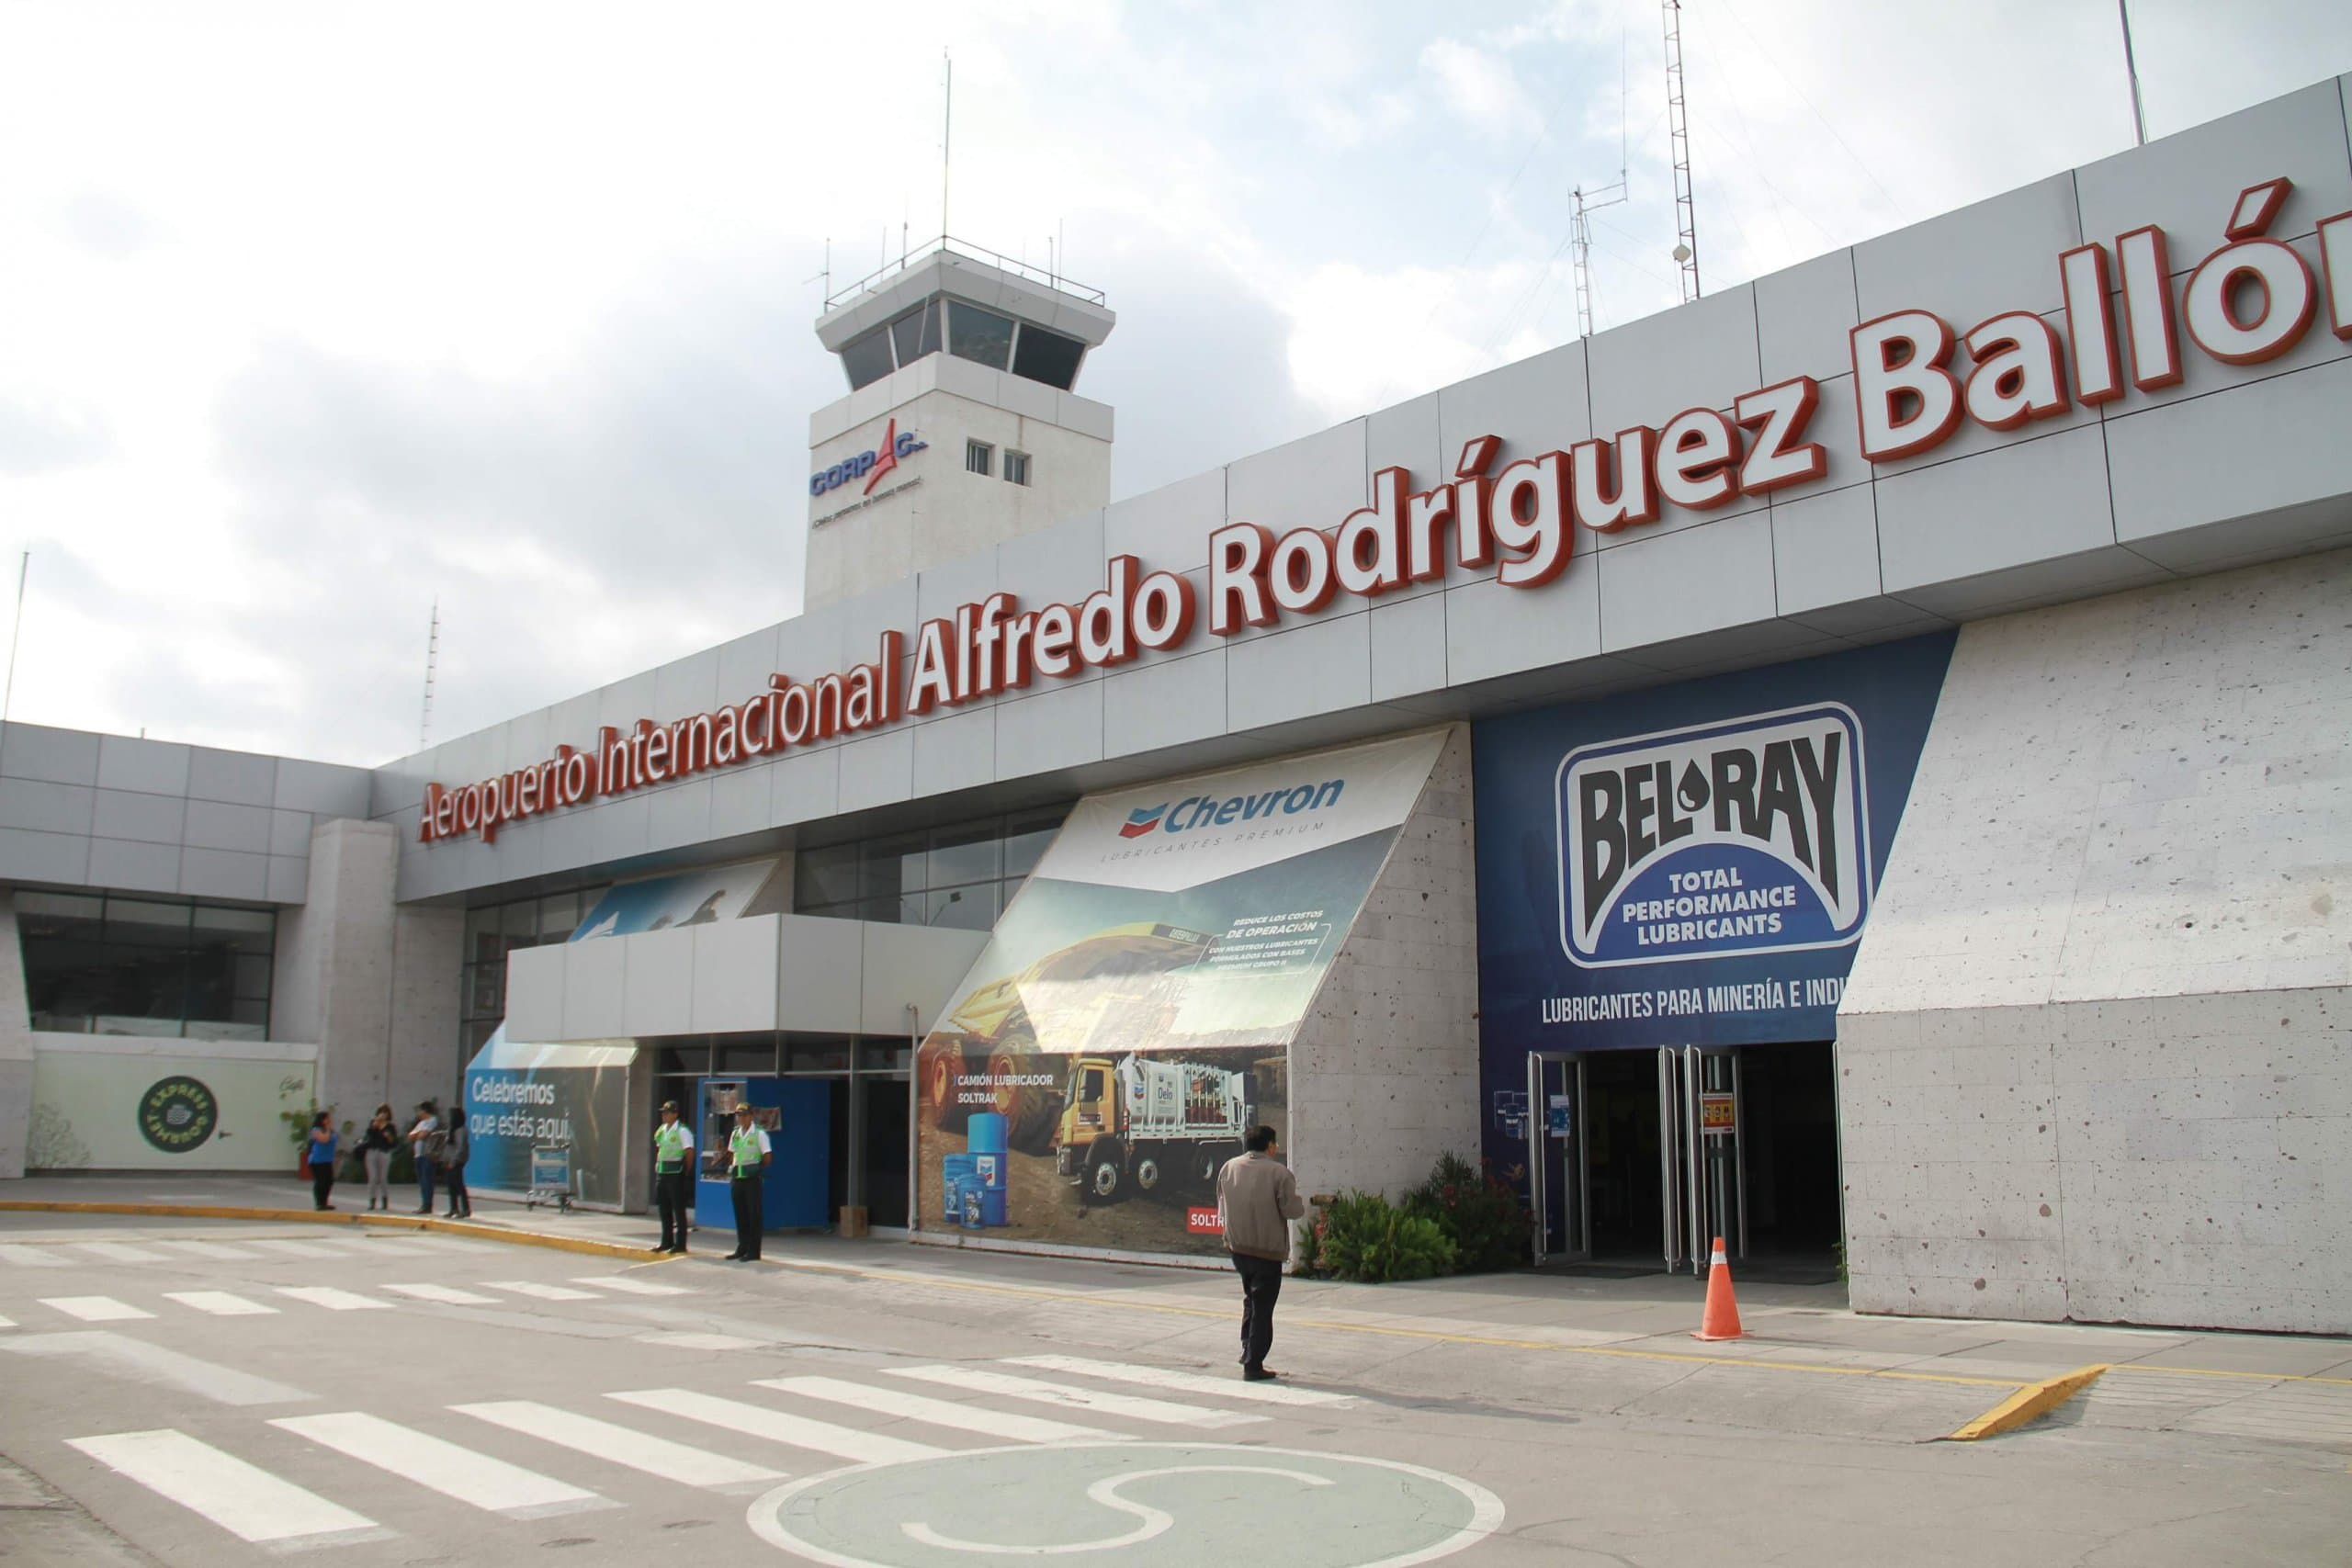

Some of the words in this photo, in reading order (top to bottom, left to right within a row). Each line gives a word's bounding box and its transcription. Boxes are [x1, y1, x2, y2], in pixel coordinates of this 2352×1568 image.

[418, 739, 597, 846] Aeropuerto
[597, 629, 905, 794] Internacional
[905, 553, 1193, 716] Alfredo
[1208, 375, 1828, 636] Rodríguez
[1164, 779, 1345, 833] Chevron
[1101, 837, 1222, 863] LUBRICANTES
[1234, 822, 1324, 842] PREMIUM
[1668, 867, 1743, 894] TOTAL
[1233, 916, 1269, 927] REDUCE
[1270, 914, 1287, 922] LOS
[1287, 910, 1324, 920] COSTOS
[1623, 885, 1797, 923] PERFORMANCE
[1225, 929, 1245, 939] DE
[1245, 921, 1317, 937] OPERACIÓN
[1265, 938, 1319, 949] LUBRICANTES
[1637, 913, 1782, 946] LUBRICANTS
[1542, 991, 1653, 1023] LUBRICANTES
[1657, 987, 1703, 1016] PARA
[1707, 977, 1785, 1013] MINERÍA
[1790, 980, 1800, 1008] E
[472, 1076, 555, 1105] Celebremos
[957, 1073, 993, 1086] CAMIÓN
[994, 1075, 1054, 1086] LUBRICADOR
[957, 1092, 999, 1104] SOLTRAK
[469, 1113, 496, 1142] que
[497, 1109, 535, 1138] estás
